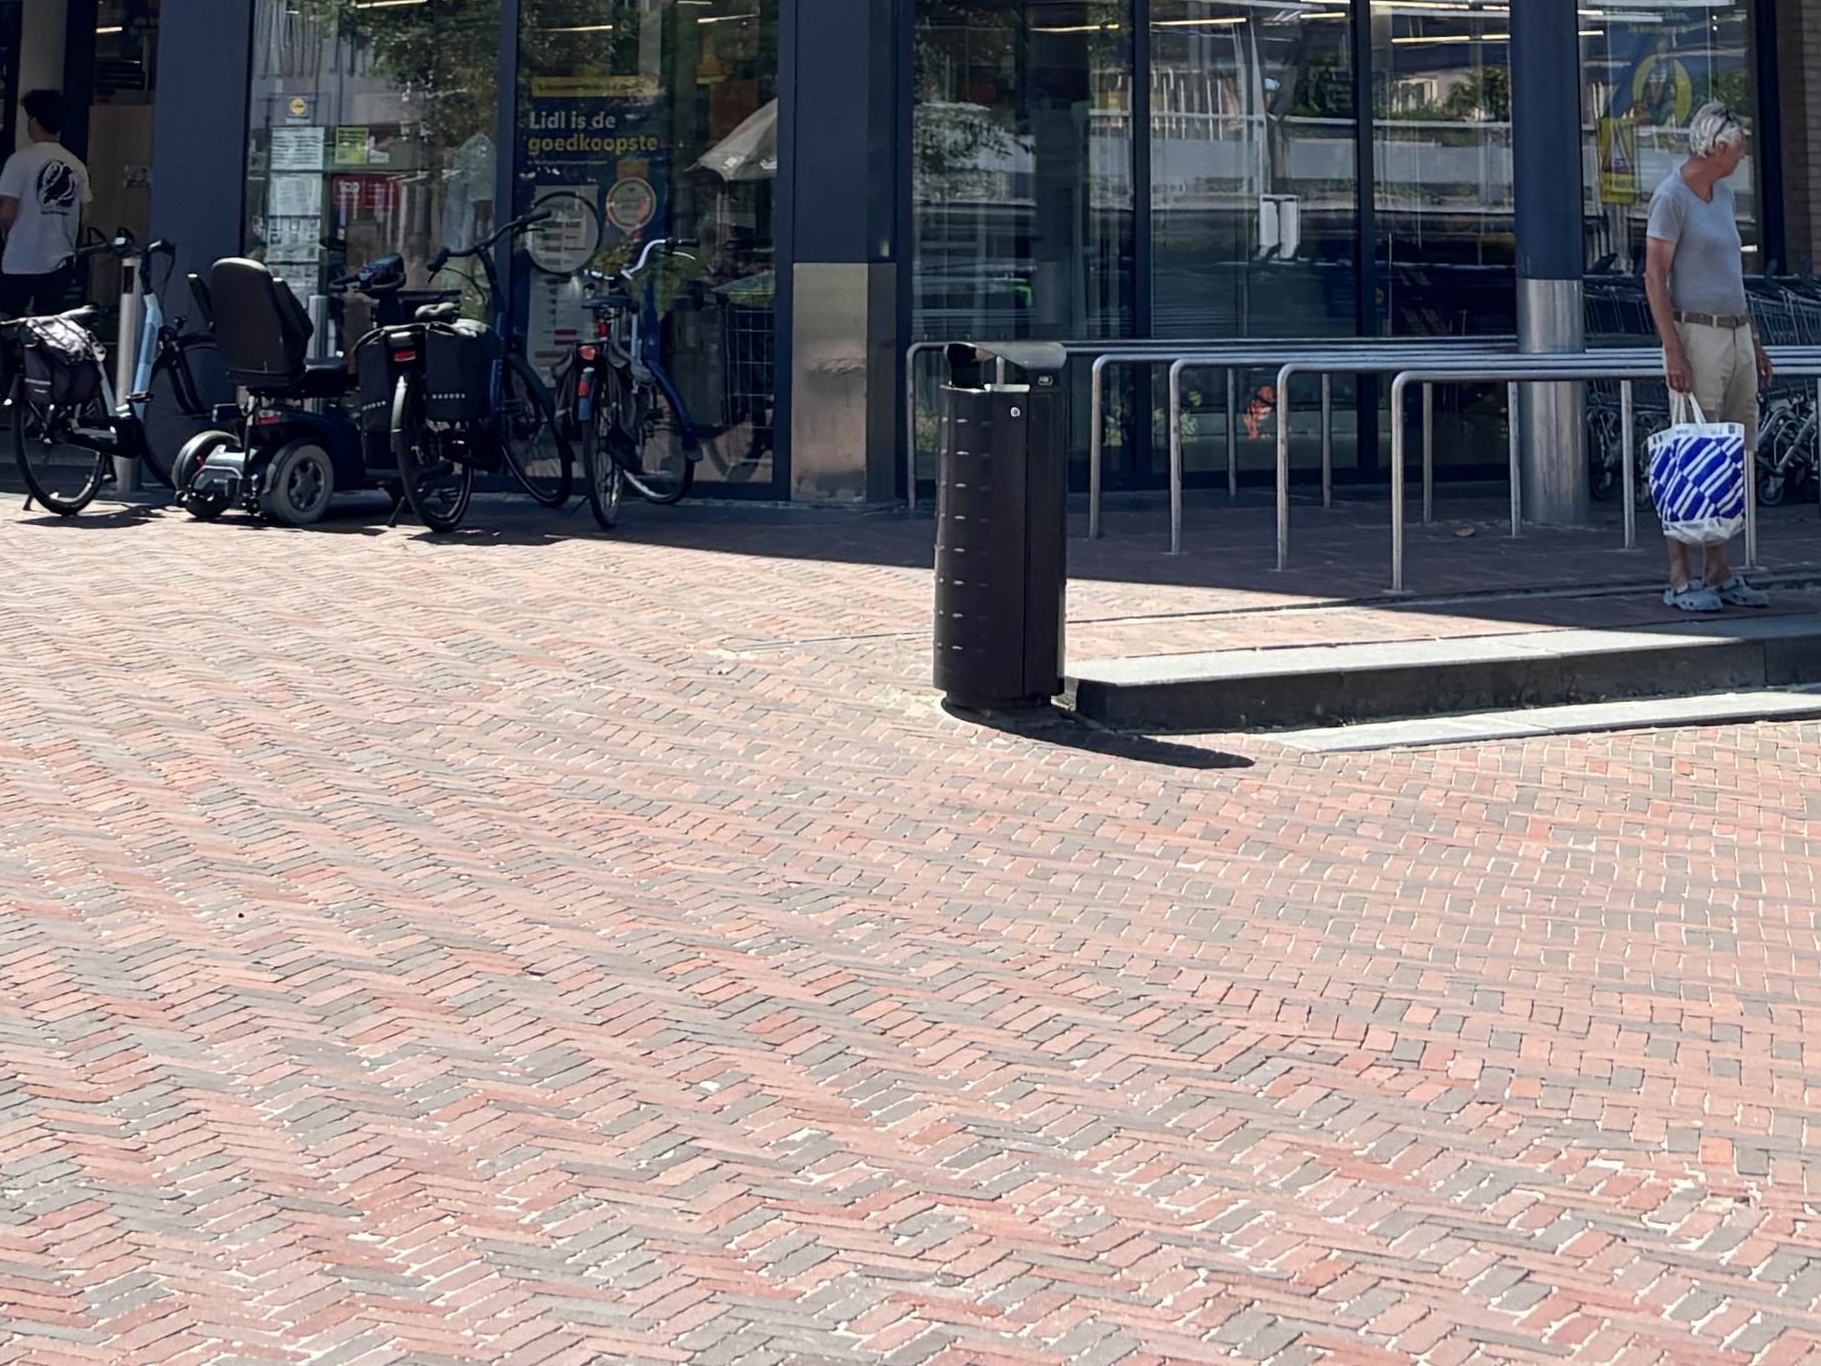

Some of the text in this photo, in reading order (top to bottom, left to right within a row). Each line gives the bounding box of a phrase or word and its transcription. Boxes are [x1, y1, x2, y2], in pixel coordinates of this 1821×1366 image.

[529, 110, 617, 129] Lidl is de
[528, 133, 658, 155] goedkoopste
